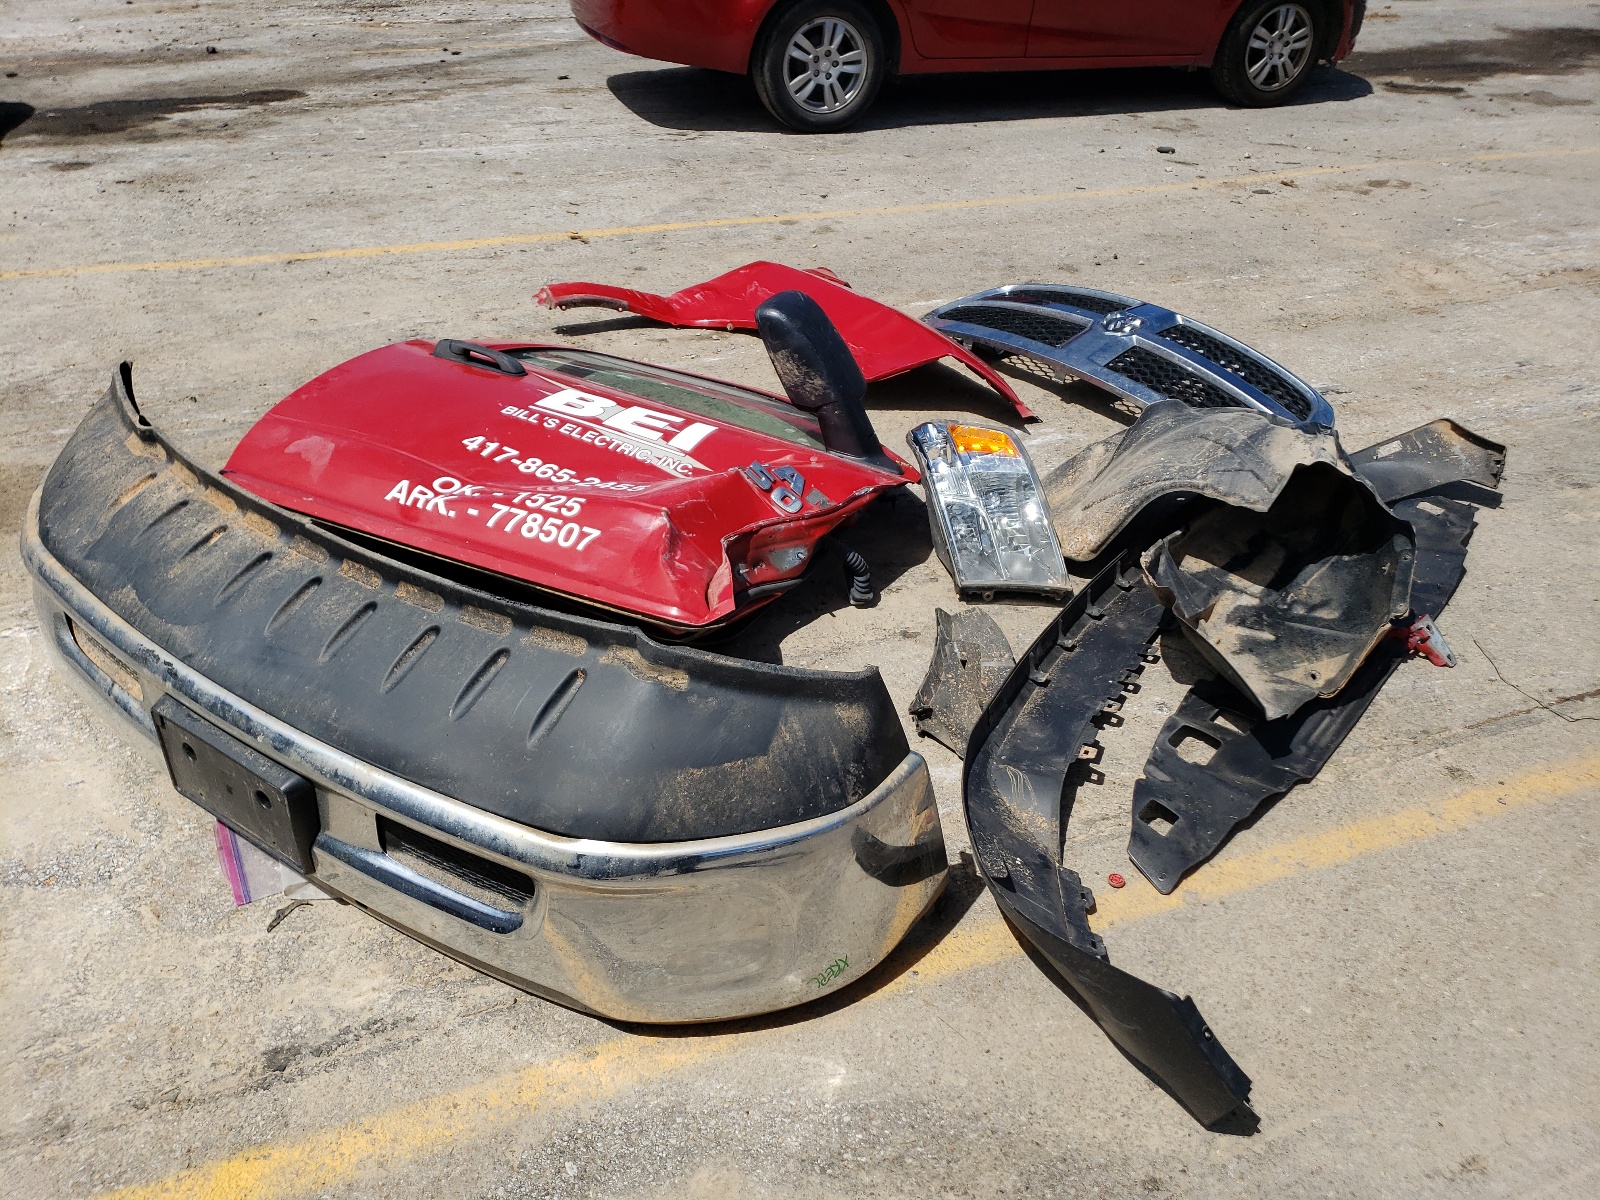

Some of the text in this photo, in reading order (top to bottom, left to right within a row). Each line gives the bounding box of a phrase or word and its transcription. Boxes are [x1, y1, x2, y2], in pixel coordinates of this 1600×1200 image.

[500, 405, 694, 475] BILL'S ELECTRIC, INC.
[533, 389, 719, 452] BEI
[384, 479, 602, 551] ARK. - 778507
[432, 476, 484, 497] OK.
[511, 491, 587, 517] 1525
